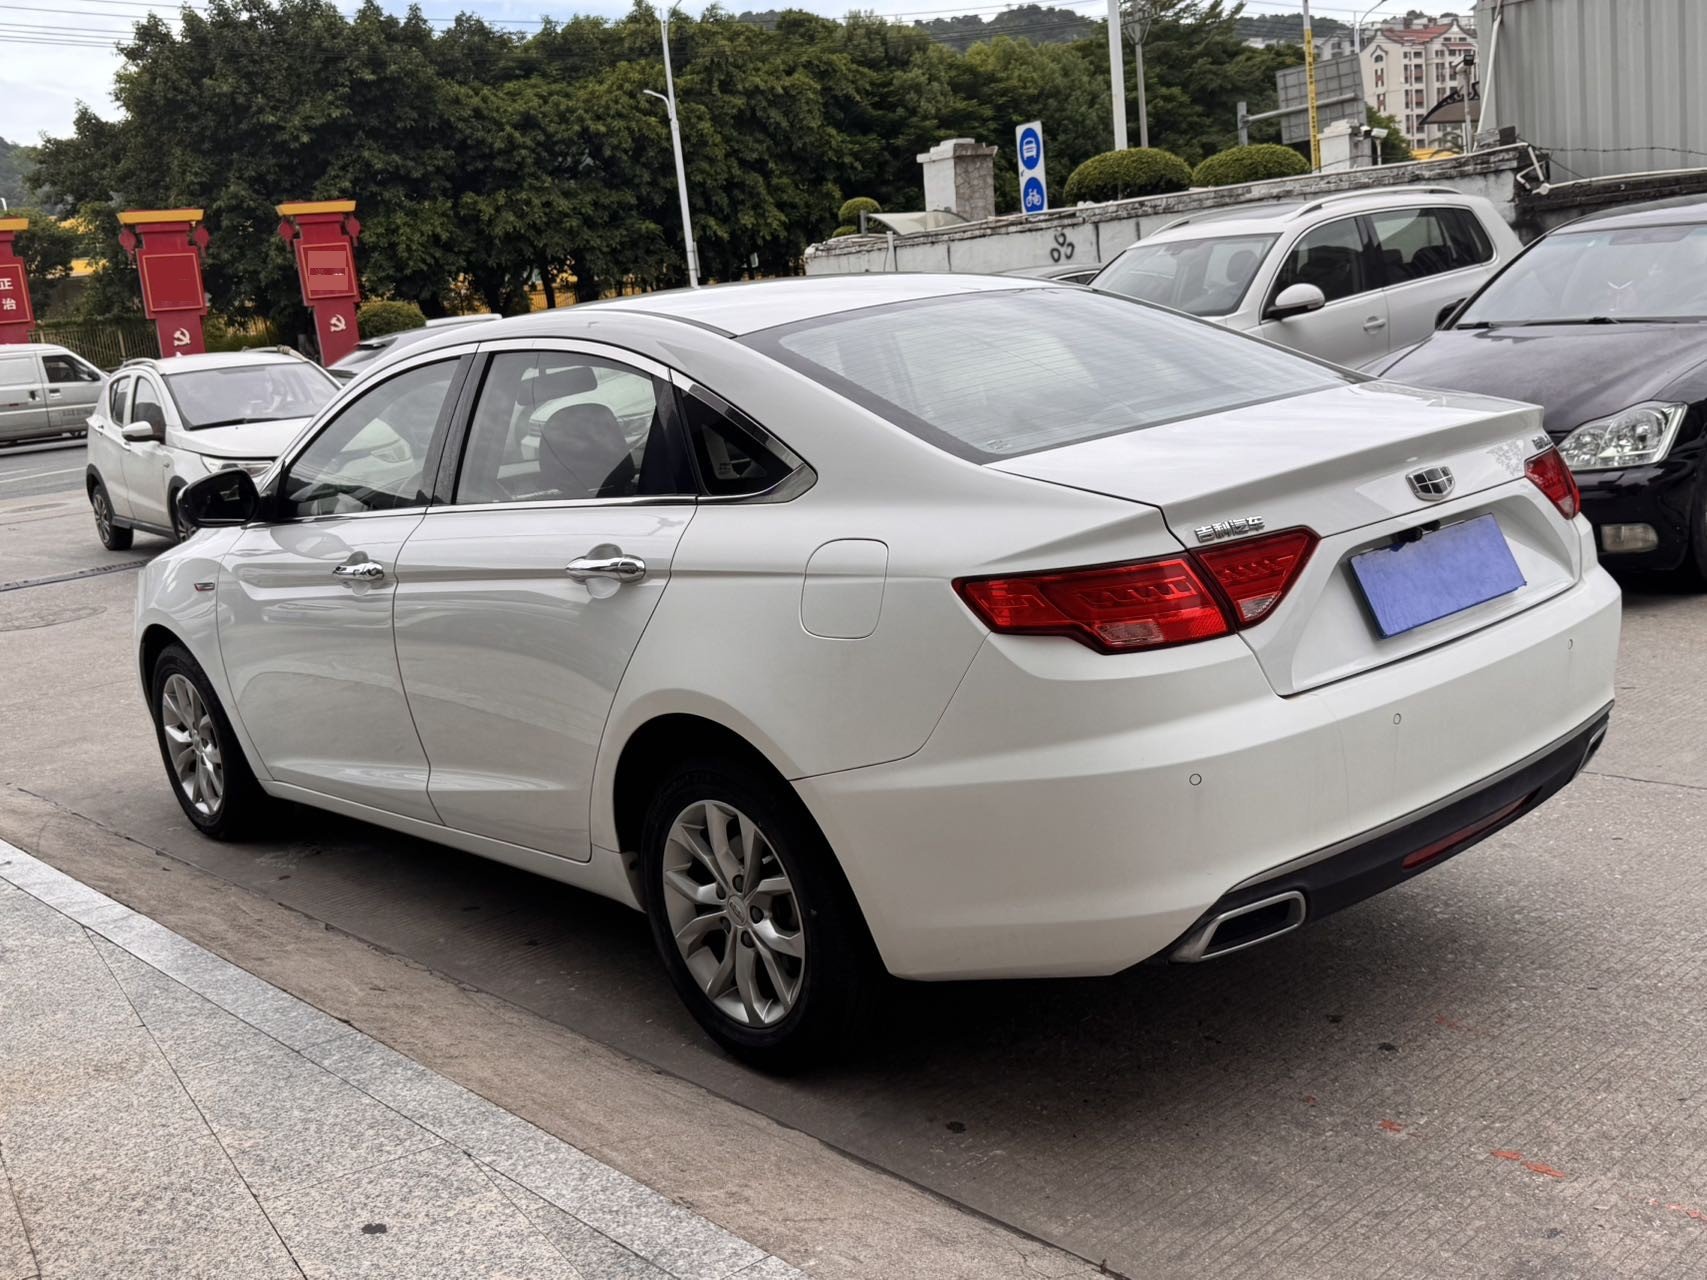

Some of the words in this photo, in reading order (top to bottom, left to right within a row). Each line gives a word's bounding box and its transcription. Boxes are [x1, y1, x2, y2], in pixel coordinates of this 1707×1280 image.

[0, 278, 14, 290] 正
[2, 297, 16, 310] 治
[1195, 516, 1264, 543] 吉利汽车
